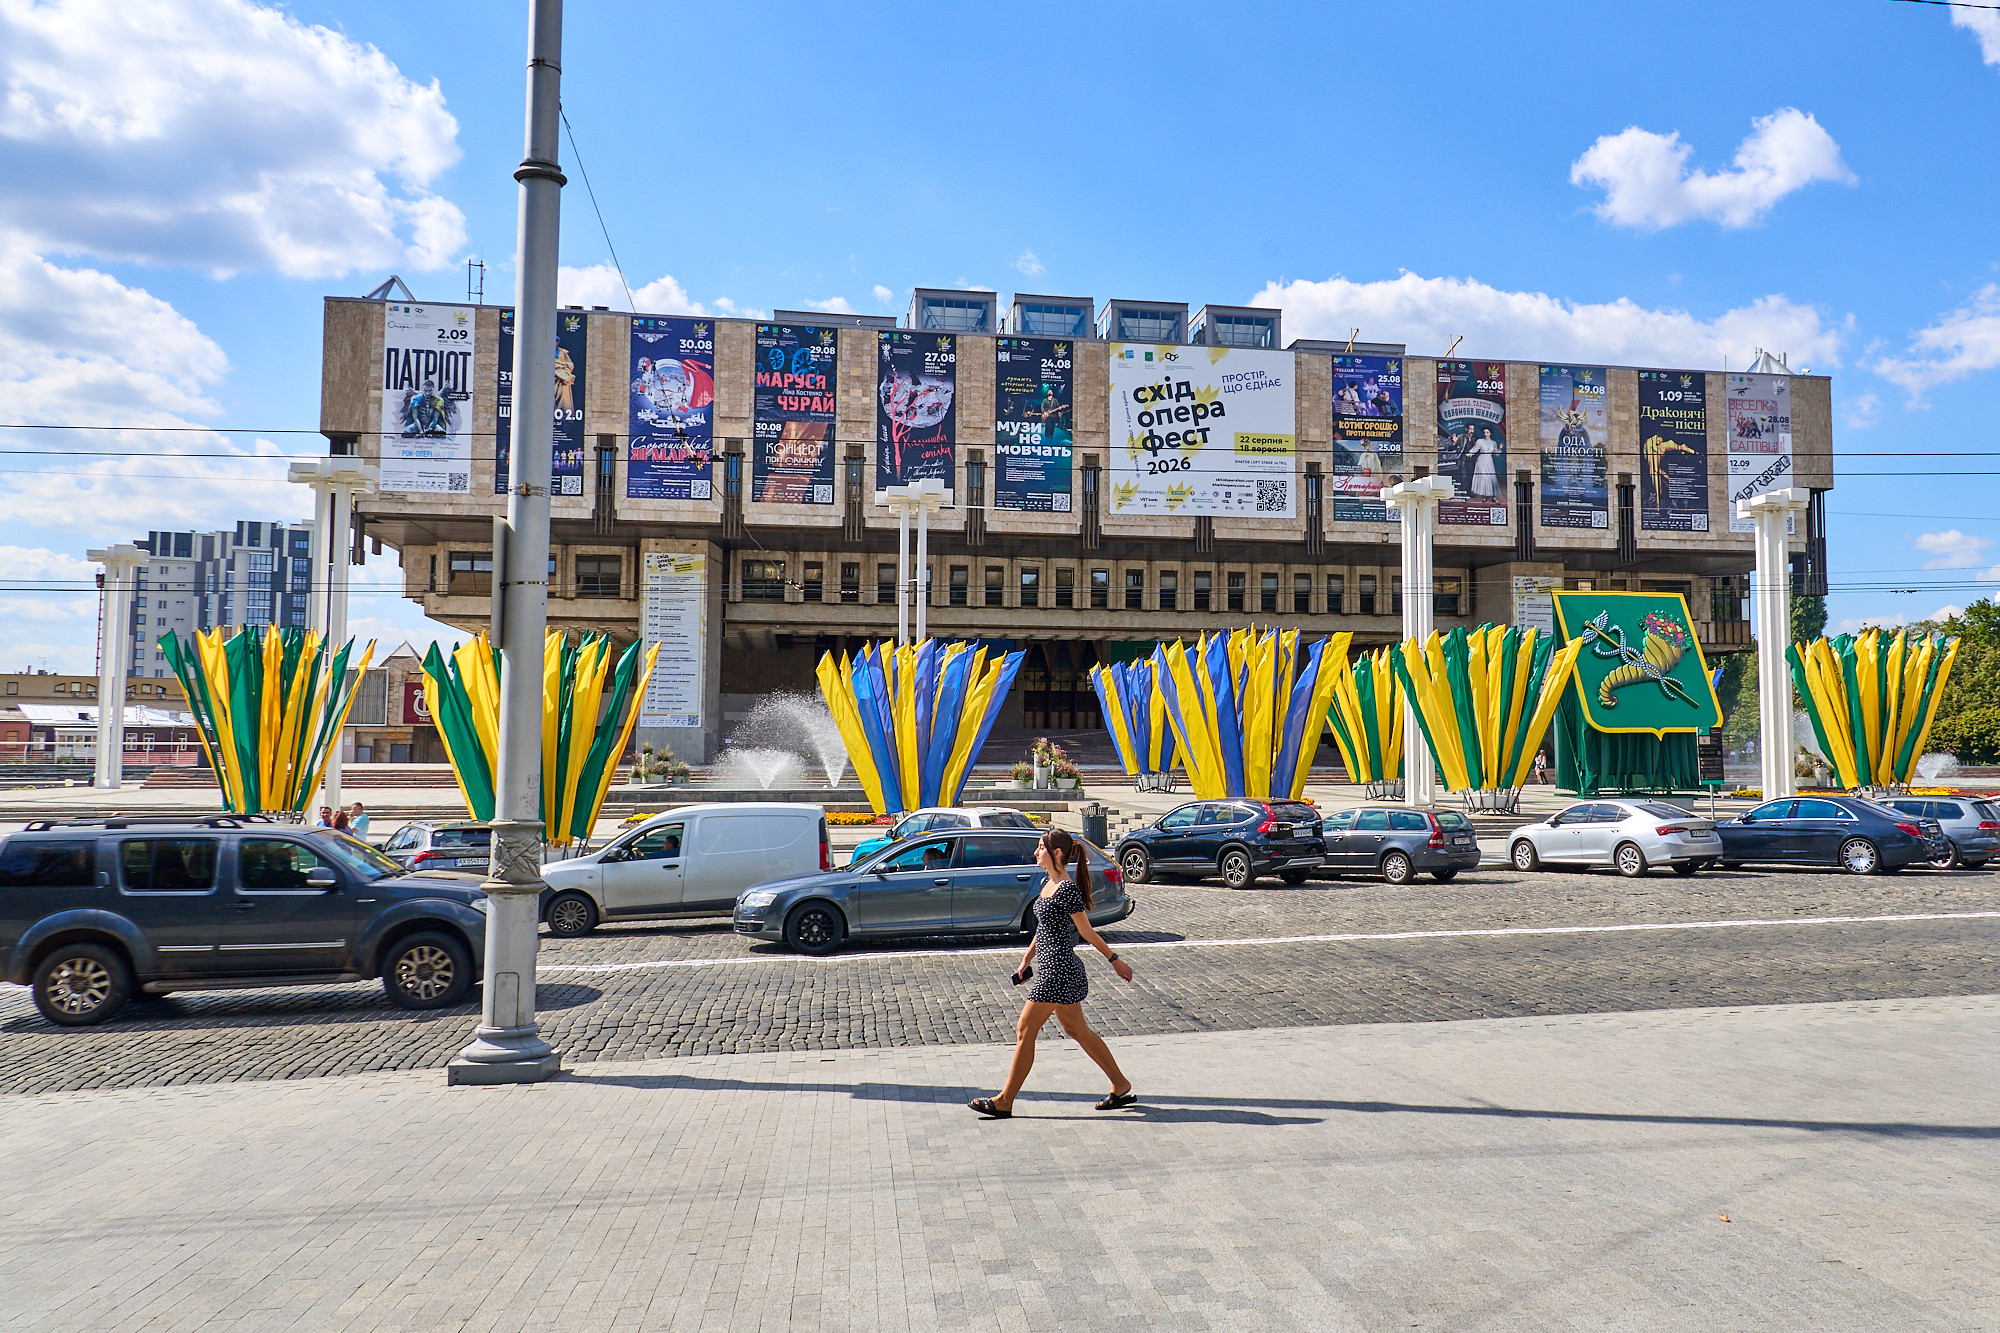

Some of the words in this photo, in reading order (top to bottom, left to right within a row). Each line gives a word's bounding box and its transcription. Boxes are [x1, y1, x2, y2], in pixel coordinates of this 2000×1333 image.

[438, 329, 468, 340] 2.09
[680, 339, 712, 350] 30.08
[810, 346, 835, 354] 29.08
[925, 353, 955, 362] 27.08
[1041, 359, 1071, 369] 24.08
[386, 348, 471, 393] ПАТРІОТ
[757, 372, 826, 389] МАРУСЯ
[1222, 371, 1267, 383] ПРОСТІР,
[1378, 375, 1400, 383] 25.08
[1133, 376, 1195, 403] схід
[1224, 384, 1242, 394] ЩО
[1246, 379, 1281, 391] ЄДНАЄ
[1477, 380, 1503, 389] 26.08
[1579, 385, 1605, 394] 29.08
[1658, 390, 1682, 401] 1.09
[778, 392, 834, 412] ЧУРАЙ
[1728, 398, 1778, 411] ВЕСЕЛКА
[565, 409, 583, 420] 2.0
[1138, 401, 1225, 427] опера
[1641, 406, 1705, 420] Драконячі
[1729, 411, 1745, 421] НА
[756, 423, 781, 431] 30.08
[997, 421, 1042, 436] музи
[1339, 421, 1398, 431] КОТИГОРОШКО
[1676, 419, 1705, 430] пісні
[1019, 434, 1042, 444] не
[1142, 427, 1210, 457] фест
[1563, 436, 1586, 446] ОДА
[766, 443, 823, 456] КОНЦЕРТ
[996, 444, 1071, 457] мовчать
[1545, 445, 1603, 457] СТІЙКОСТІ
[1730, 440, 1778, 453] САЛТІВЦІ
[766, 456, 782, 464] ПРИ
[1147, 457, 1191, 475] 2026
